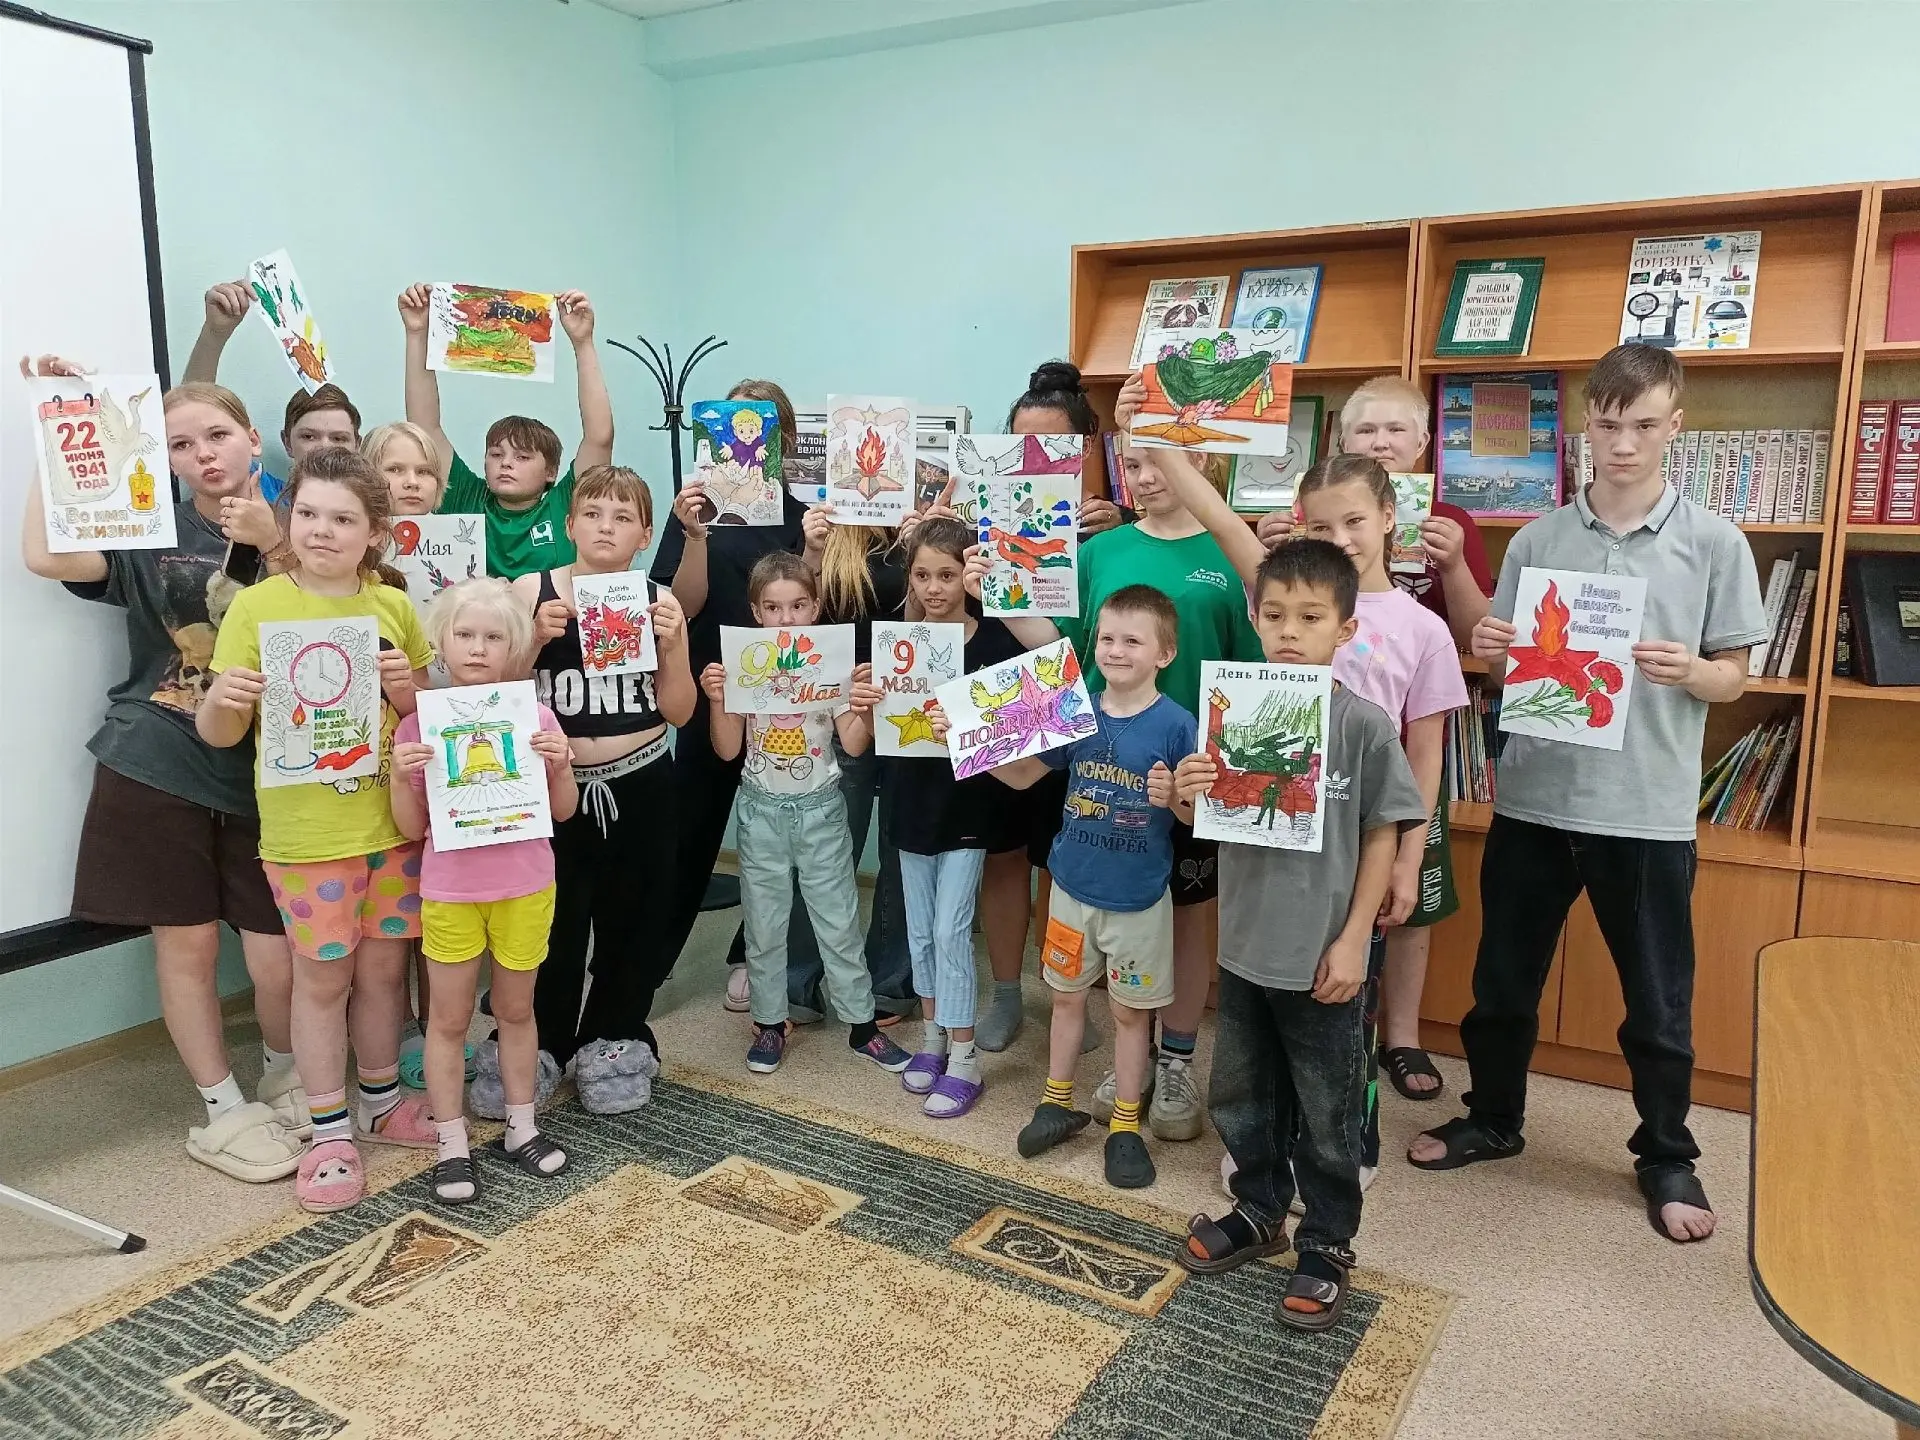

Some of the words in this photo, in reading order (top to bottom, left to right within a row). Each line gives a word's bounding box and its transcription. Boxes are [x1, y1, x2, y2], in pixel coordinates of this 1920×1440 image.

[1634, 254, 1714, 269] ФИЗИКА
[1246, 281, 1310, 299] МИРА
[1254, 276, 1292, 288] АТЛАС
[57, 421, 100, 451] 22
[796, 436, 826, 445] ОКЛОН
[1673, 450, 1682, 469] МИР
[1686, 450, 1696, 469] МИР
[1700, 449, 1709, 470] МИР
[1714, 453, 1724, 470] МИР
[1728, 449, 1739, 468] МИР
[1741, 454, 1751, 472] МИР
[1754, 450, 1765, 468] МИР
[1782, 449, 1793, 469] МИР
[1798, 446, 1809, 465] МИР
[1815, 451, 1826, 471] МИР
[68, 463, 108, 479] 1941
[76, 479, 110, 490] года
[1710, 471, 1721, 504] ПОЗНАЮ
[1723, 471, 1736, 506] ПОЗНАЮ
[1736, 473, 1748, 506] ПОЗНАЮ
[1749, 470, 1762, 504] ПОЗНАЮ
[1779, 470, 1791, 506] ПОЗНАЮ
[1794, 466, 1807, 506] ПОЗНАЮ
[1811, 472, 1823, 507] ПОЗНАЮ
[65, 507, 91, 524] Во
[94, 508, 129, 523] имя
[393, 520, 421, 556] 9
[413, 538, 453, 556] Мая
[607, 585, 630, 594] День
[1580, 583, 1621, 600] Наша
[1573, 598, 1624, 614] память
[1570, 620, 1631, 640] бессмертие
[737, 640, 779, 688] 9
[892, 640, 915, 675] 9
[1216, 667, 1252, 680] День
[1258, 669, 1319, 683] Победы
[314, 708, 347, 720] Никто
[314, 721, 327, 730] не
[958, 701, 1054, 751] ПОБЕДА!
[313, 742, 326, 750] не
[573, 764, 621, 777] CFILNE
[1075, 760, 1145, 793] WORKING
[1325, 790, 1350, 801] didas
[1079, 830, 1149, 853] DUMPER
[1423, 865, 1442, 912] ISLAND
